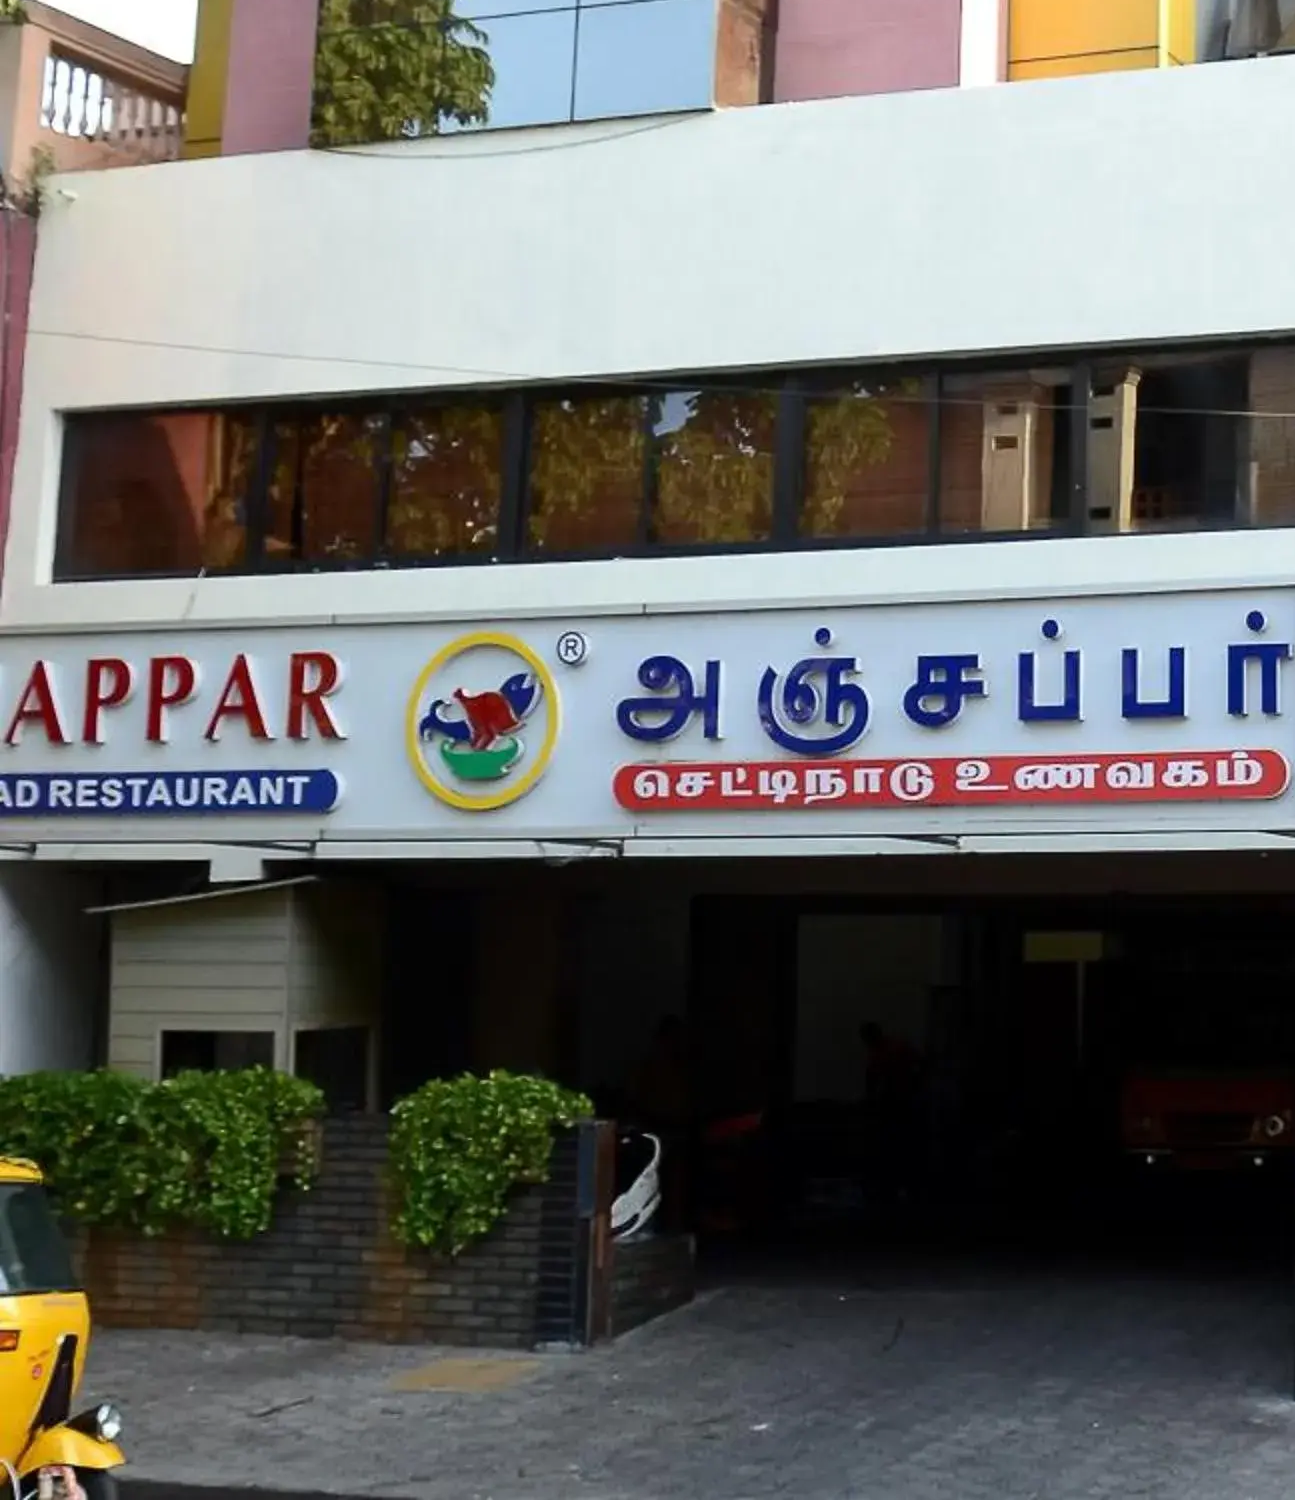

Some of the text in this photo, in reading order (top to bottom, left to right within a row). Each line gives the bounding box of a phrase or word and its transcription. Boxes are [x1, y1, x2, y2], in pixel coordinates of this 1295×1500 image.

[4, 650, 347, 746] APPAR
[616, 609, 1294, 755] அஞ்சப்பர்
[48, 775, 310, 808] RESTAURANT
[633, 761, 935, 804] செட்டிநாடு
